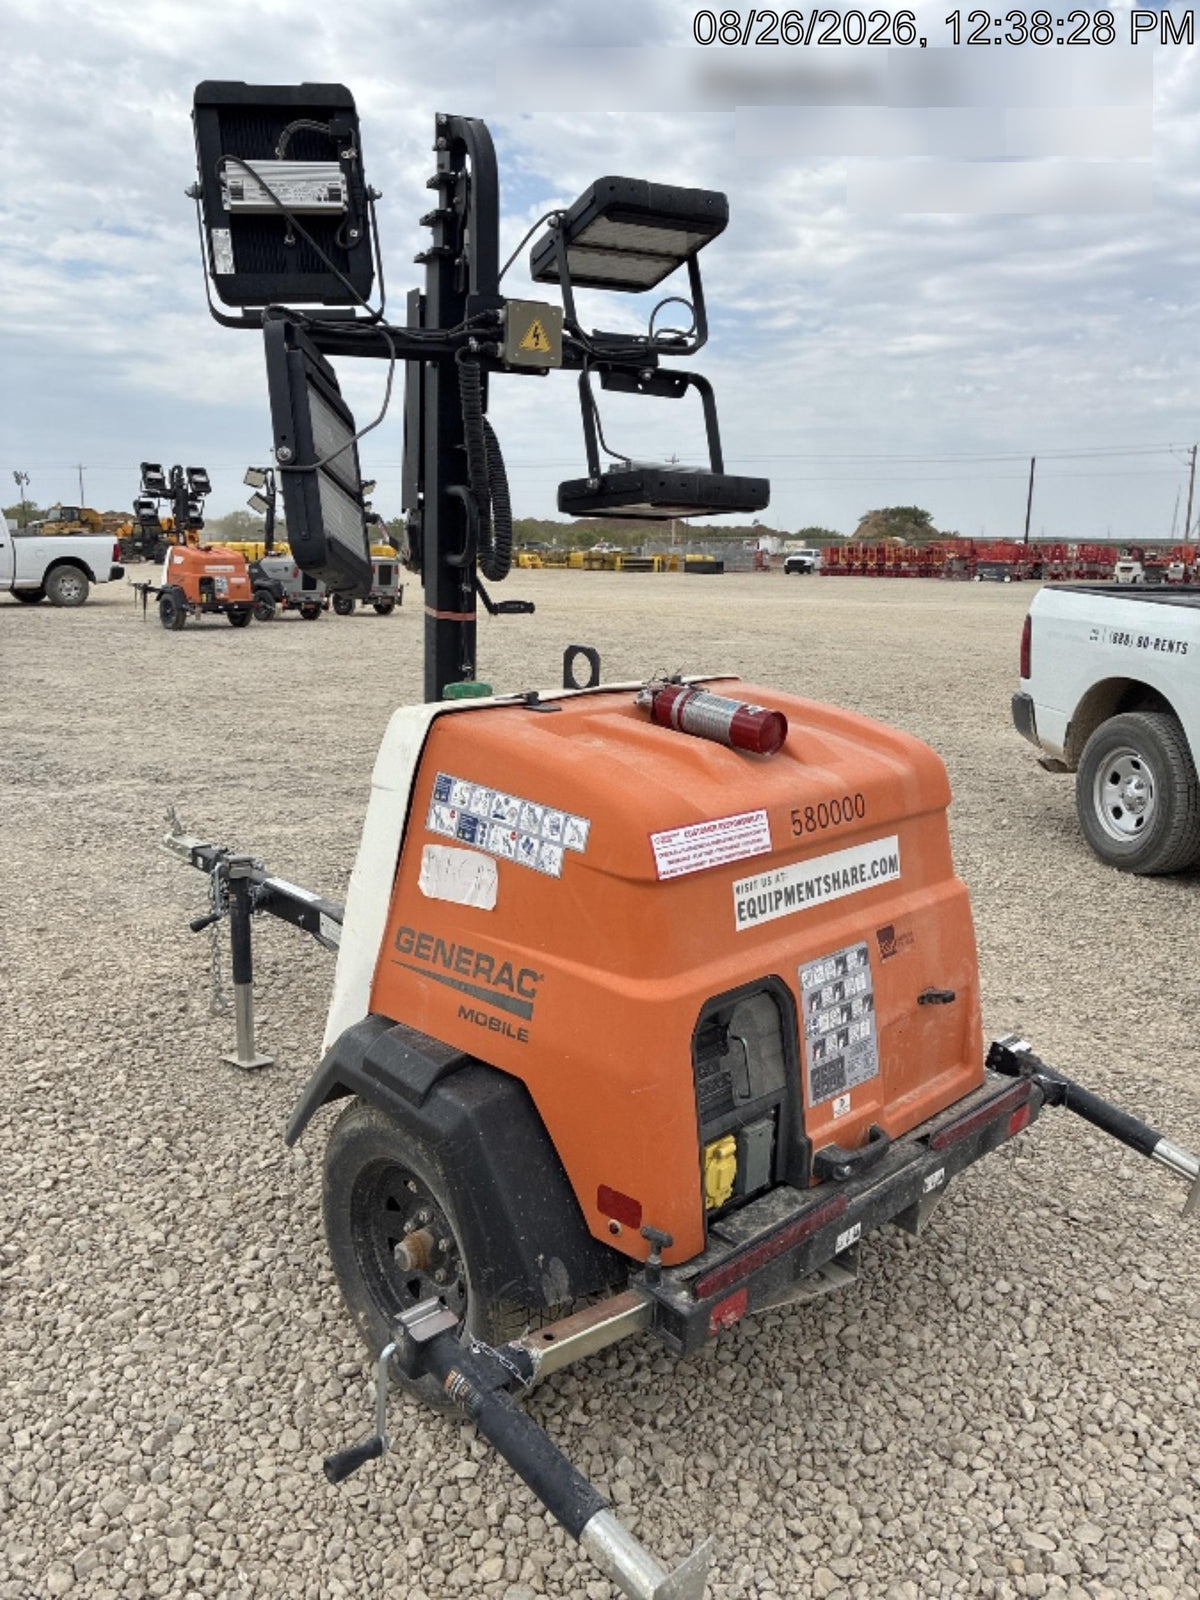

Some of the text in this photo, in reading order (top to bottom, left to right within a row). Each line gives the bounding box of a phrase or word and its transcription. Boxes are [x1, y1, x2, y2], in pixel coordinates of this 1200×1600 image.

[790, 793, 866, 836] 580000
[736, 878, 758, 896] VISIT
[760, 875, 773, 889] US
[737, 854, 899, 921] EQUIPMENTSHARE.COM
[394, 926, 538, 999] GENERAC
[457, 1004, 530, 1043] MOBILE
